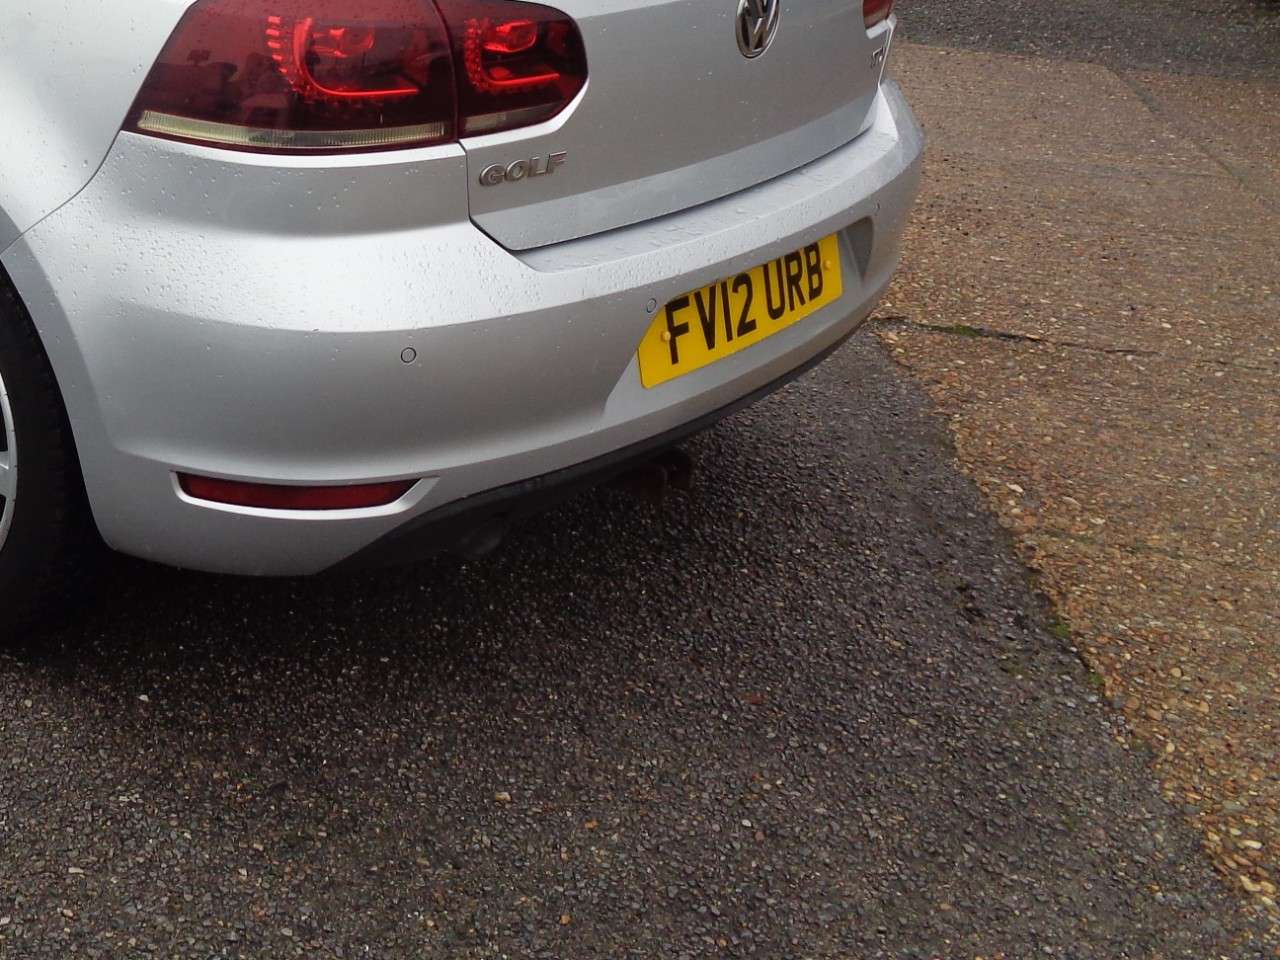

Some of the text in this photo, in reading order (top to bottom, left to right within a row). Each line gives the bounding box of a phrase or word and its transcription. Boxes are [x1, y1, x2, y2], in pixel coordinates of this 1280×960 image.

[478, 149, 568, 187] GOLF
[664, 241, 824, 366] FV12 URB
